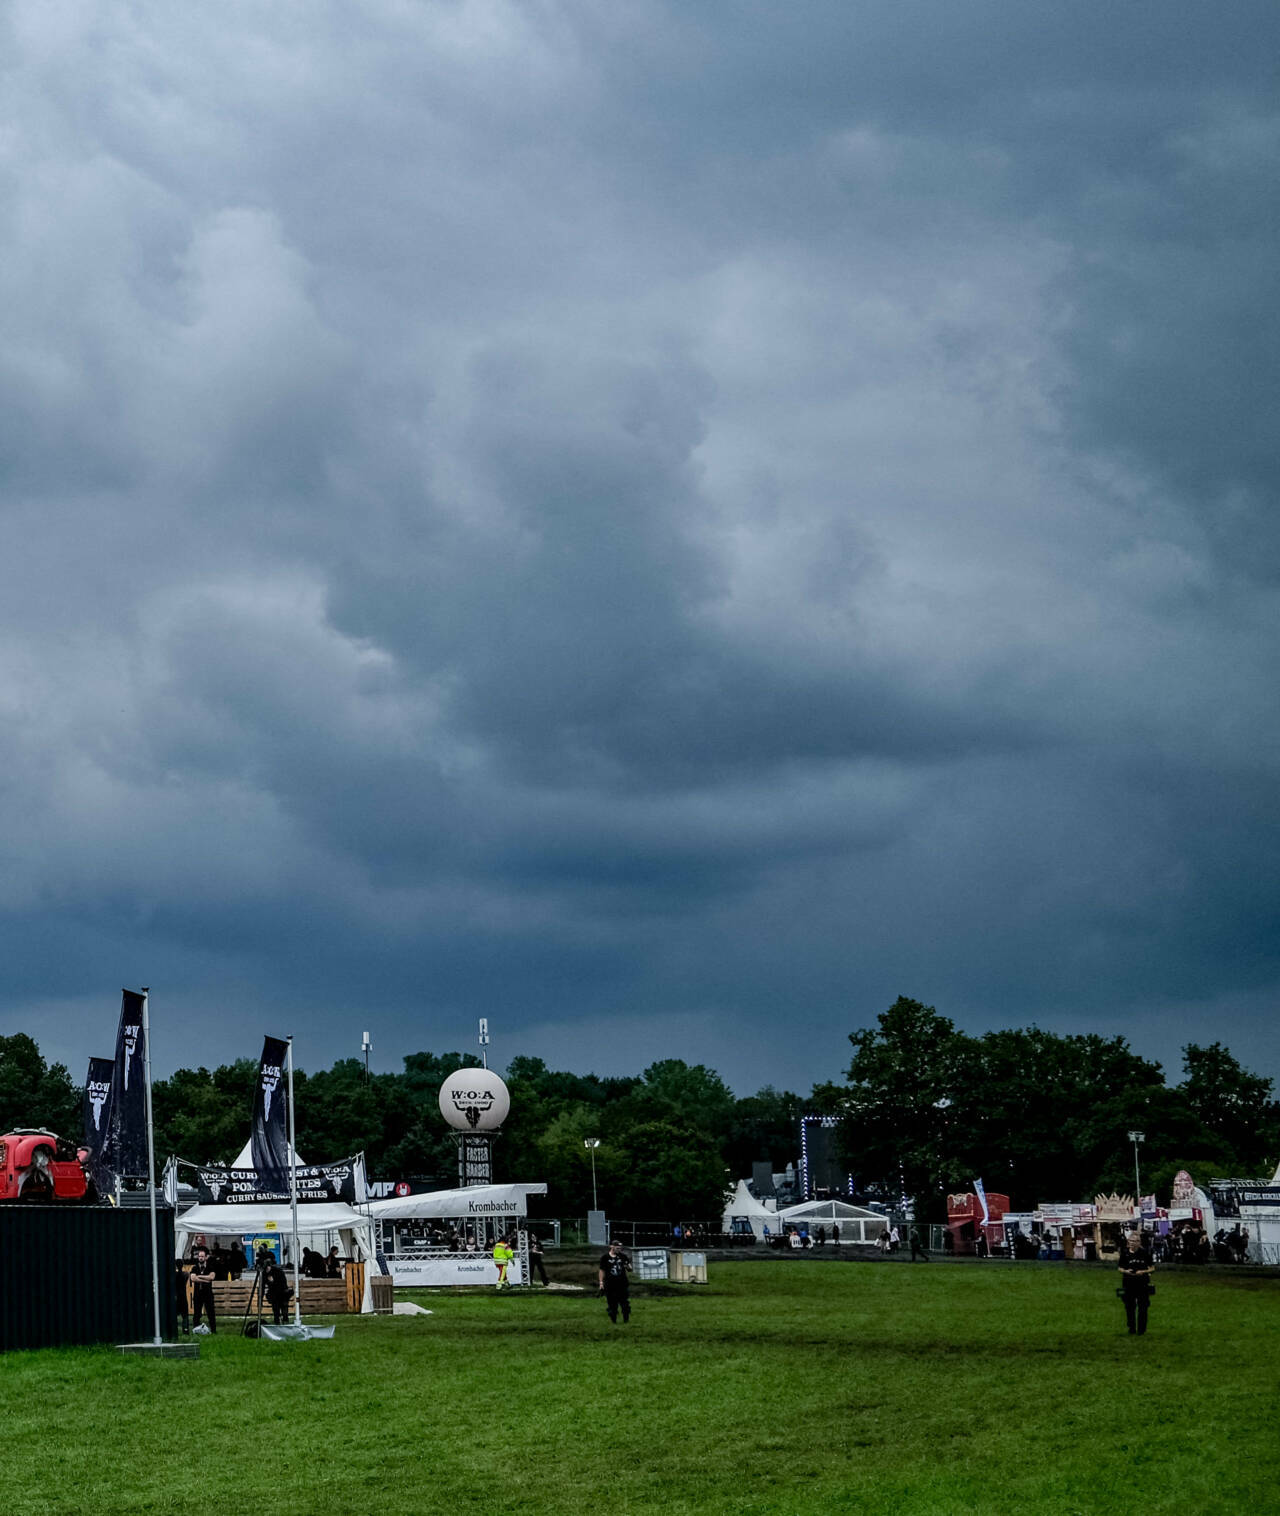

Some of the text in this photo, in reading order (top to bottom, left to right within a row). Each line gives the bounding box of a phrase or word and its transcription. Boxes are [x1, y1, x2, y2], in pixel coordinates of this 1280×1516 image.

[451, 1091, 495, 1100] W:O:A
[226, 1193, 255, 1204] CURRY
[301, 1190, 329, 1199] FRIES
[469, 1200, 518, 1213] Krombacher
